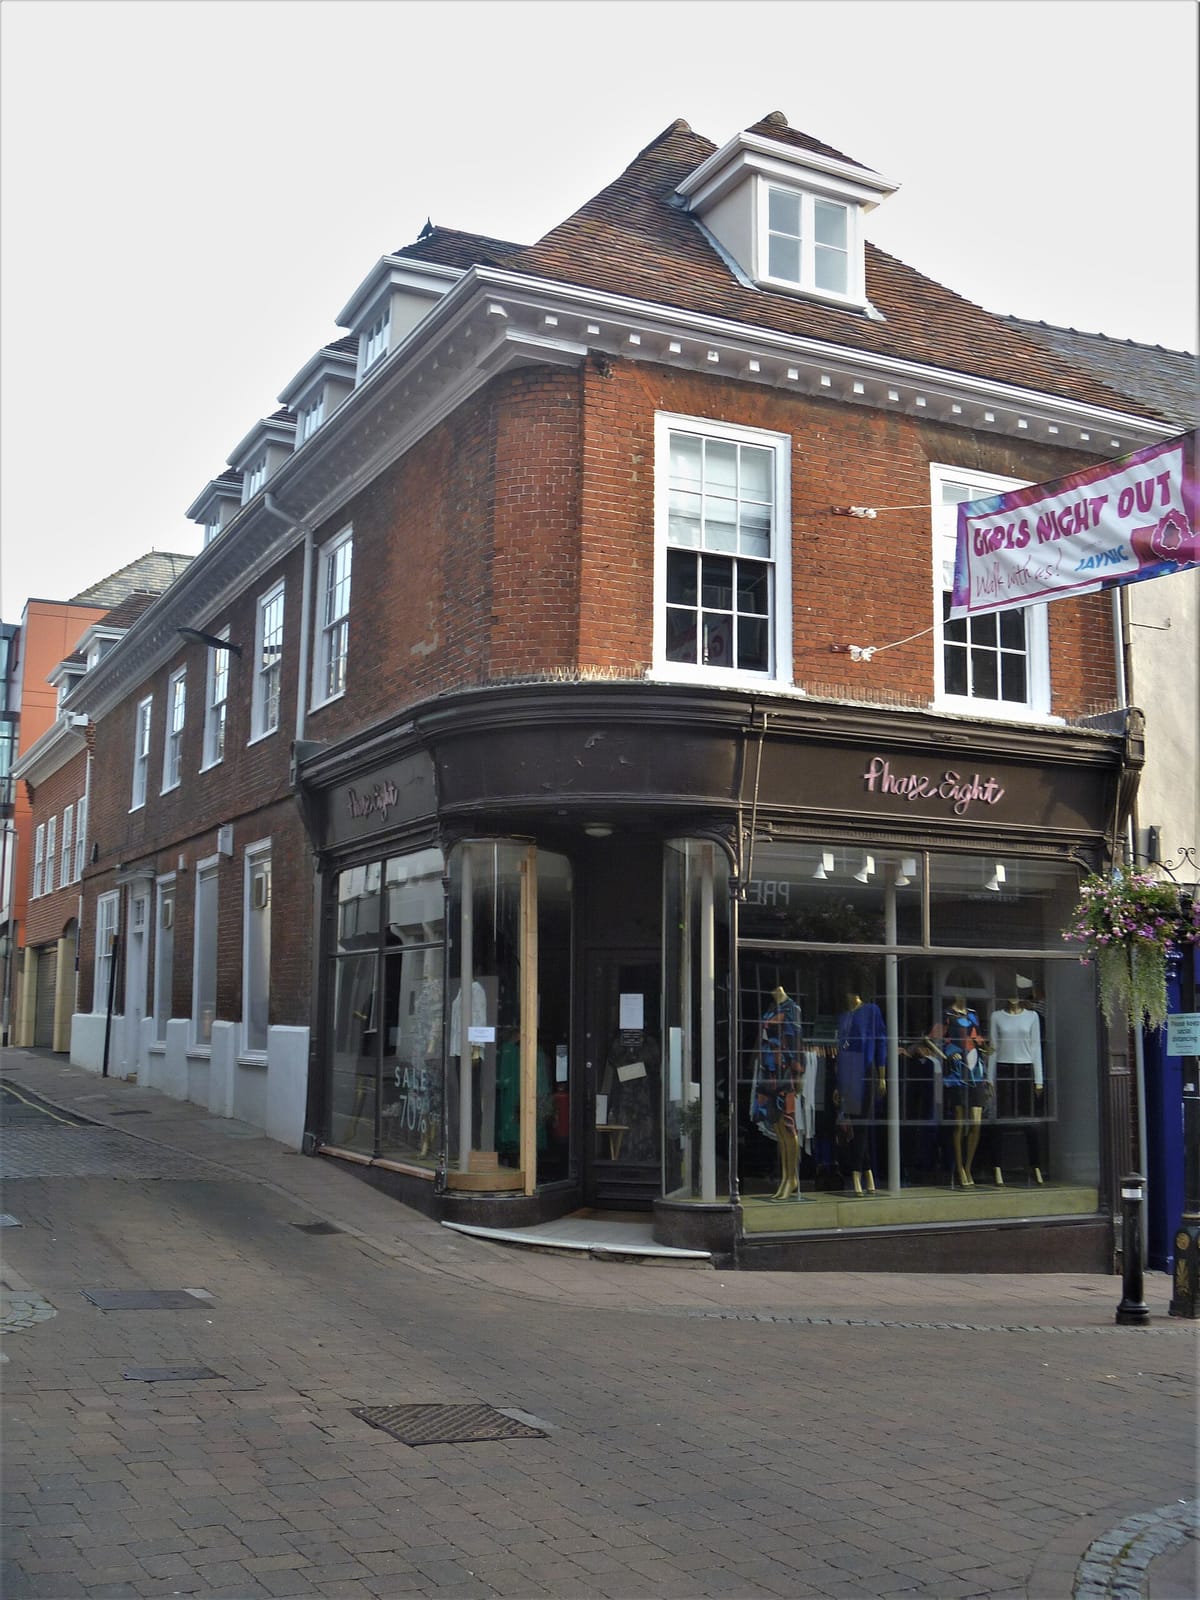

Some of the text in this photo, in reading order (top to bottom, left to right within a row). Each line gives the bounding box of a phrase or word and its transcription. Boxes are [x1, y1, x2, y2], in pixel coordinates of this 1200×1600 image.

[973, 470, 1171, 557] GIRLS NIGHT OUT
[976, 561, 1004, 598] Walk
[1007, 554, 1032, 589] with
[1074, 544, 1129, 572] JAYNIC
[863, 756, 1006, 816] Phase Eight
[394, 1065, 428, 1091] SALE
[400, 1094, 427, 1133] 70%
